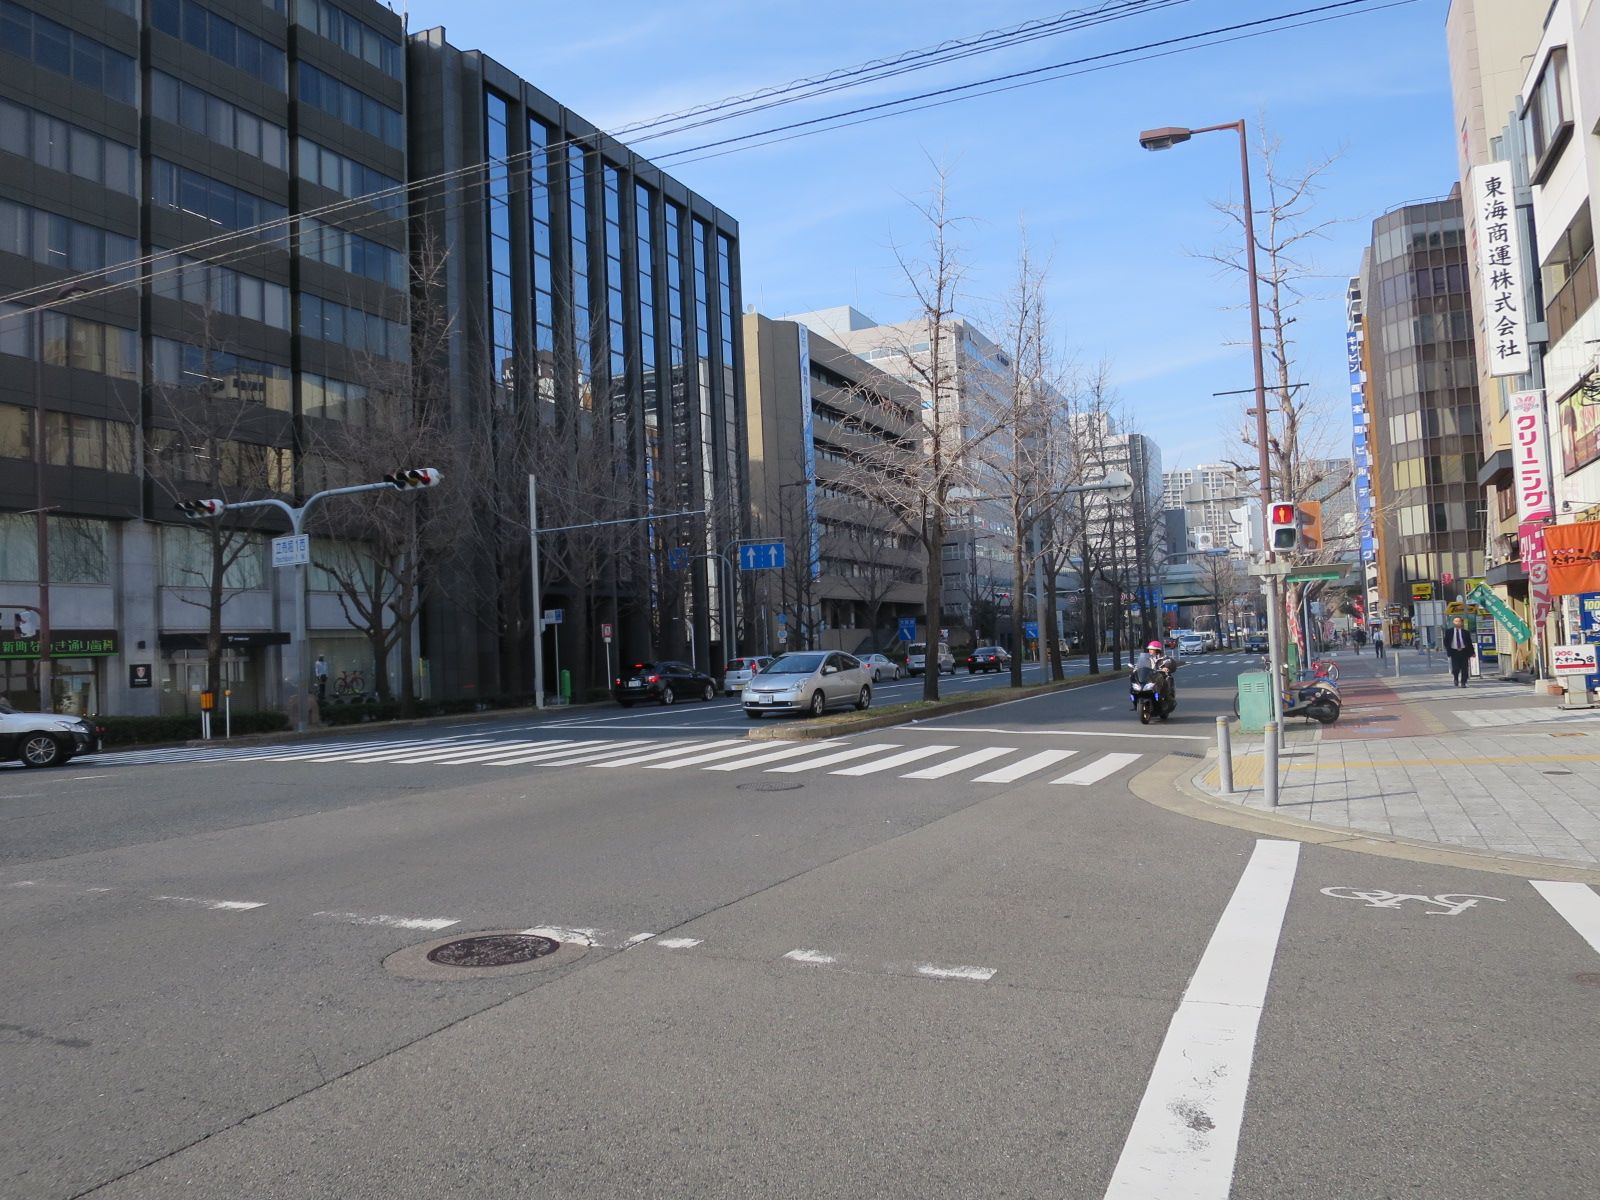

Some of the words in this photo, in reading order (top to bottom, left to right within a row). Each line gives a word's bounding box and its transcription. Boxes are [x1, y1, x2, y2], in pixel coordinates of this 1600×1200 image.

[1484, 176, 1521, 360] 東海商運株式会社
[1517, 415, 1547, 507] クリーニング
[3, 639, 113, 653] 新町なき通り歯科
